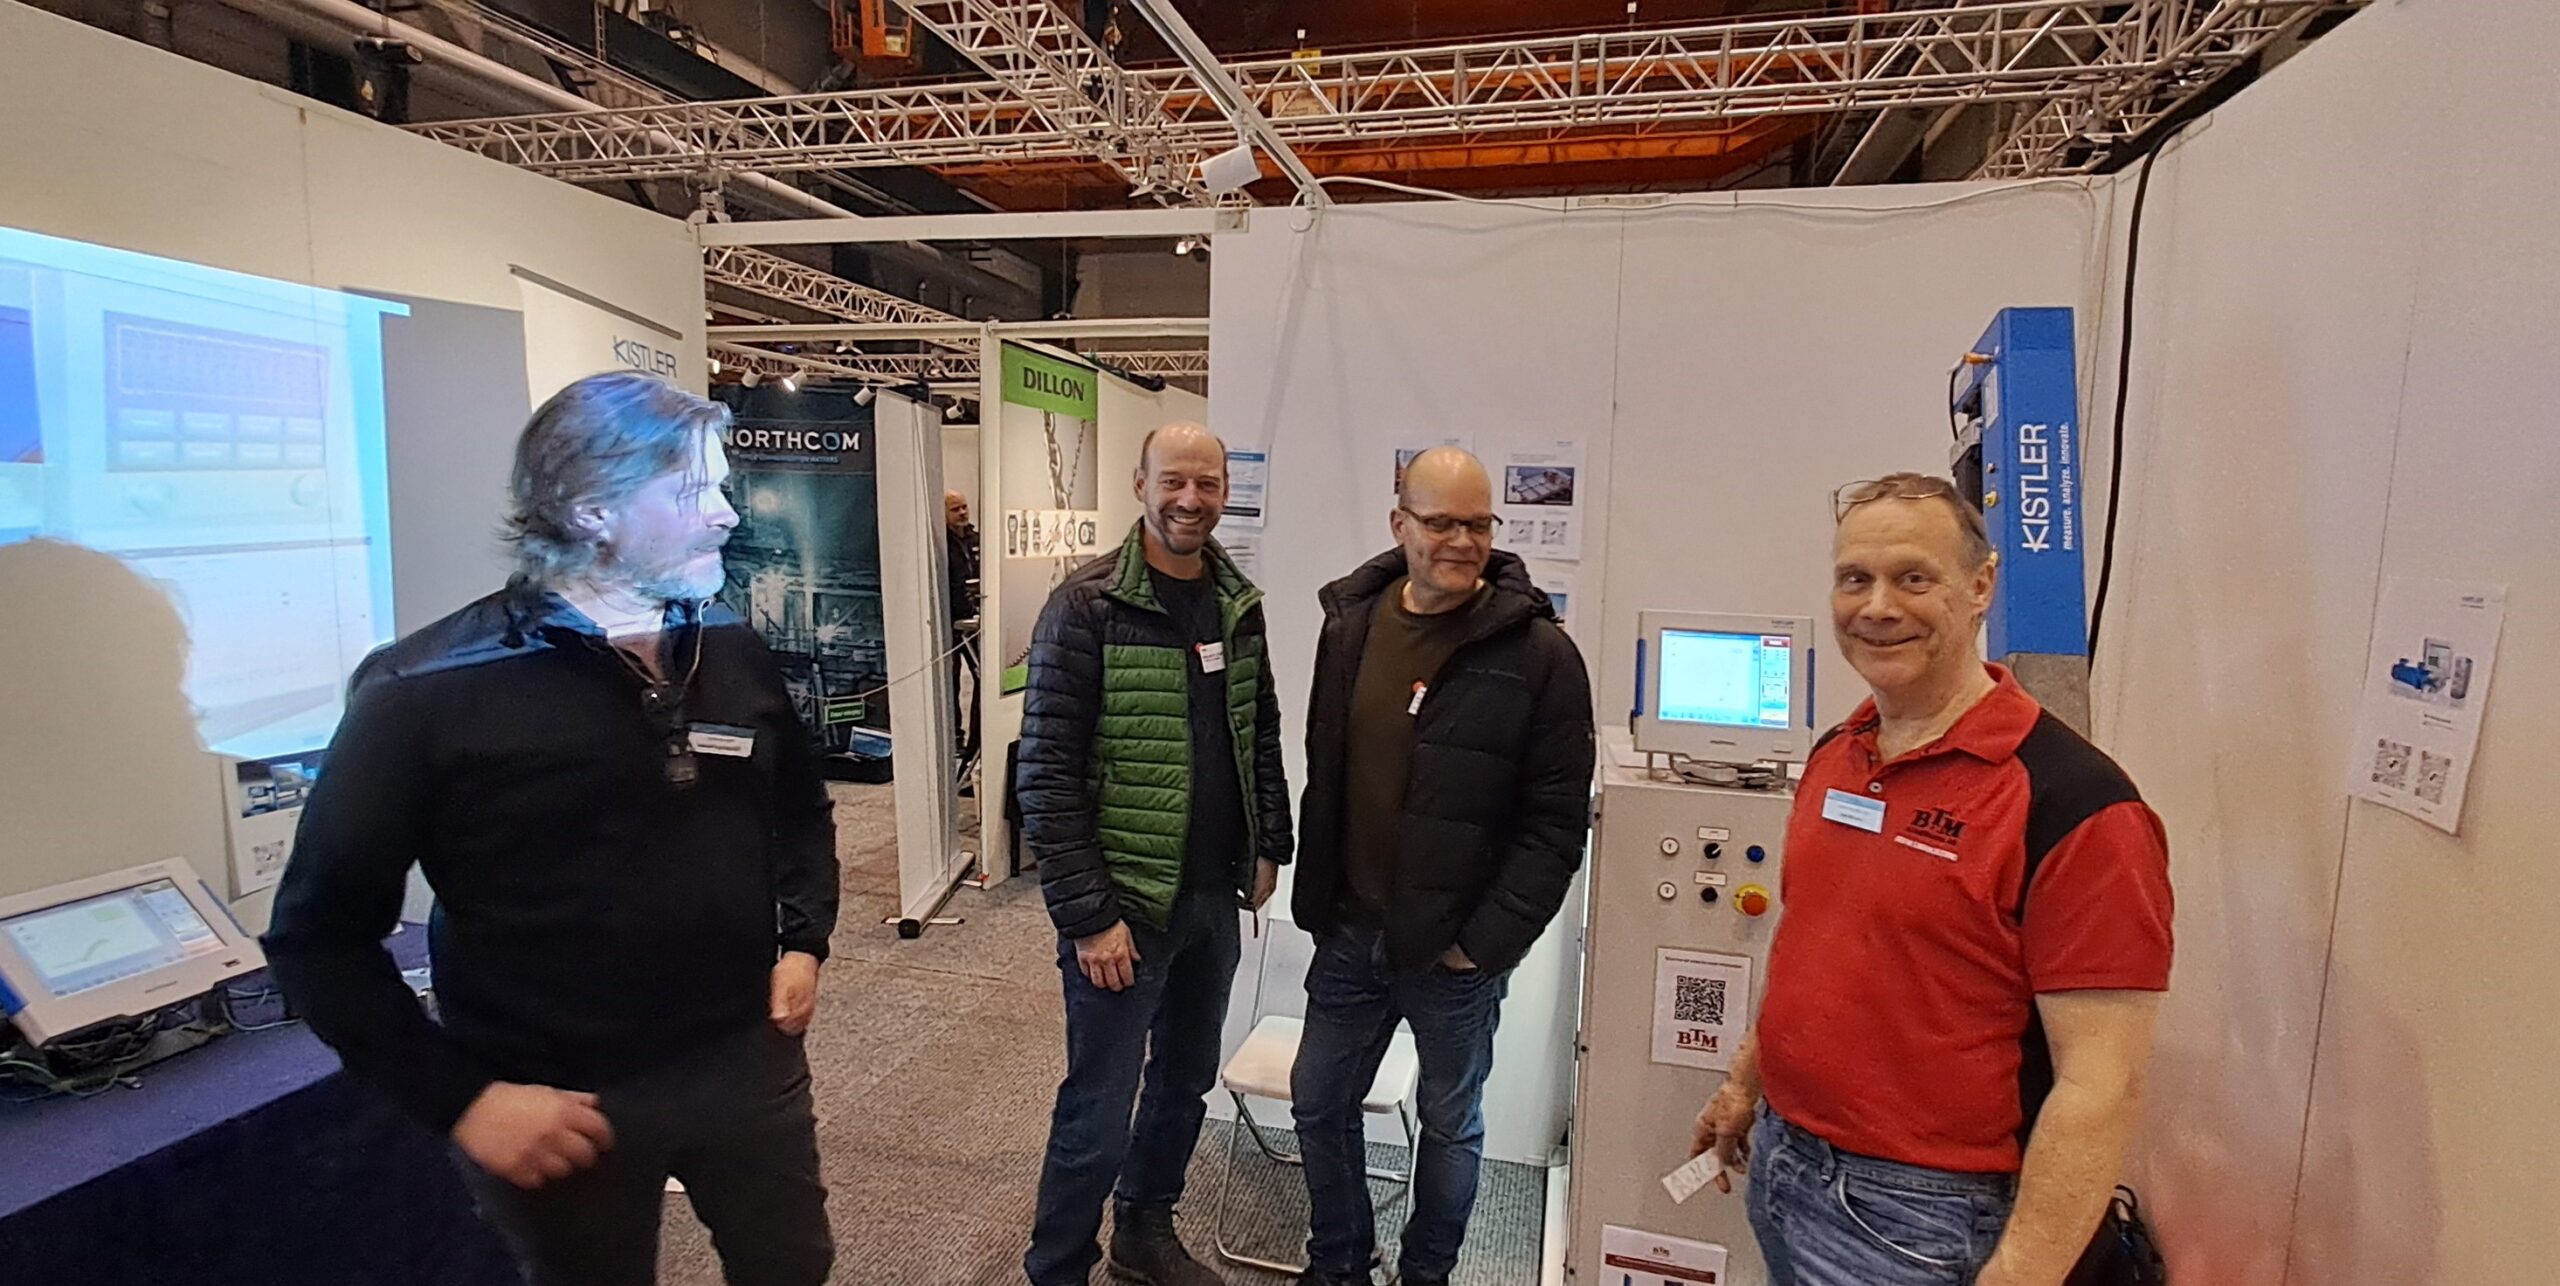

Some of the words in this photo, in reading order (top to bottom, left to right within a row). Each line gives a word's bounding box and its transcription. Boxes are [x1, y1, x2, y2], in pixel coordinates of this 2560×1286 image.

[613, 335, 678, 379] KISTLER
[1023, 366, 1085, 402] DILLON
[724, 428, 860, 451] NORTHCOM
[2058, 421, 2071, 464] innovate.
[2020, 423, 2050, 553] KISTLER
[2060, 466, 2074, 505] analyze.
[2062, 507, 2073, 551] measure.
[1910, 807, 1967, 838] BTM
[1677, 1028, 1719, 1049] BTM
